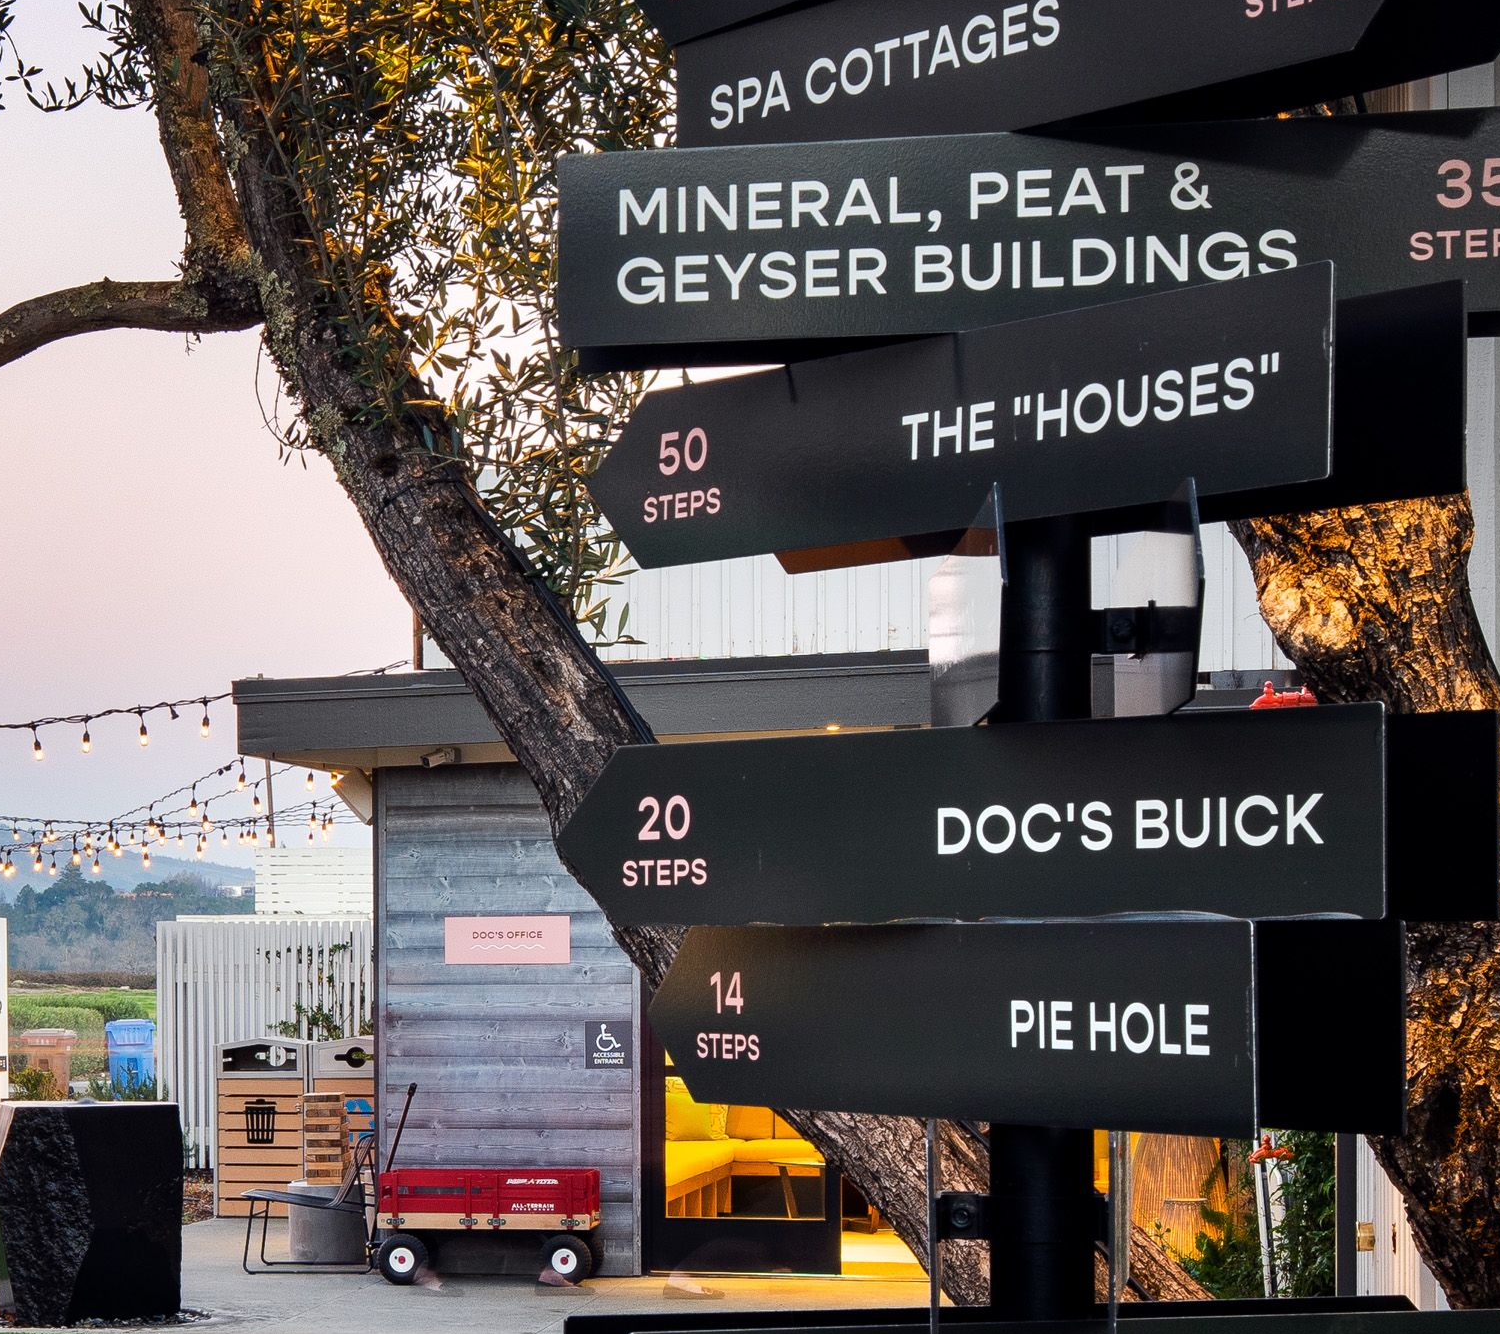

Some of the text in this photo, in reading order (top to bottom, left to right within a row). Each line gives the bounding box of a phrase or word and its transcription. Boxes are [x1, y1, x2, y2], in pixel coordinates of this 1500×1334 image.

[711, 70, 790, 129] SPA
[620, 162, 1212, 235] MINERAL, PEAT &
[617, 229, 1297, 304] GEYSER BUILDINGS
[902, 352, 1279, 460] THE "HOUSES"
[659, 428, 707, 475] 50
[644, 488, 720, 522] STEPS
[639, 795, 690, 840] 20
[938, 793, 1324, 854] DOC'S BUICK
[623, 859, 707, 886] STEPS
[472, 931, 543, 939] DOC'S OFFICE
[711, 972, 743, 1014] 14
[697, 1033, 759, 1060] STEPS
[1011, 1000, 1210, 1055] PIE HOLE
